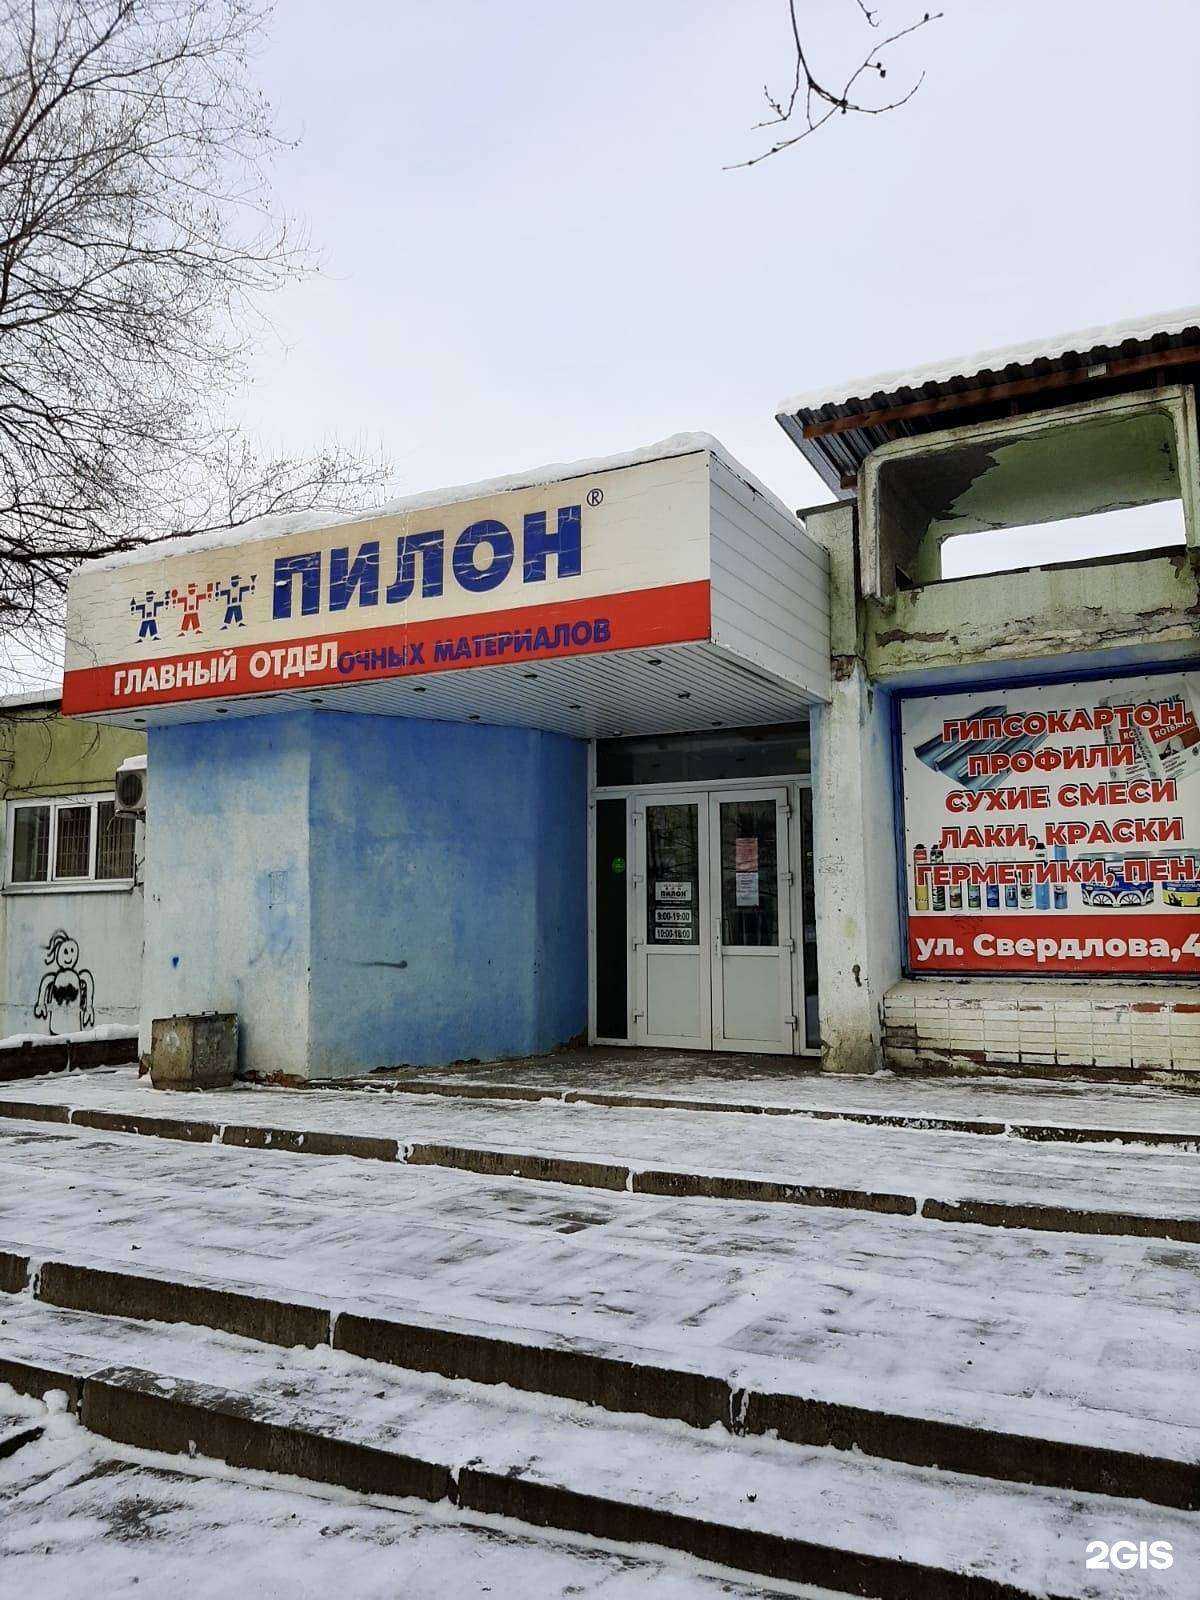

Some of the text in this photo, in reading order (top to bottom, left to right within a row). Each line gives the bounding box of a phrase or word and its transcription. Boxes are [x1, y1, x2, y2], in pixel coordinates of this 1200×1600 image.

[273, 504, 582, 620] ПИЛОН
[113, 649, 237, 696] ГЛАВНЫЙ
[433, 618, 611, 663] МАТЕРИАЛОВ
[942, 699, 1187, 743] ГИПСОКАРТОН
[967, 744, 1136, 777] ПРОФИЛИ
[944, 779, 1178, 814] СУХИЕ СМЕСИ
[938, 817, 1184, 850] ЛАКИ, КРАСКИ
[915, 859, 1116, 887] ГЕРМЕТИКИ,
[915, 936, 964, 961] ул.
